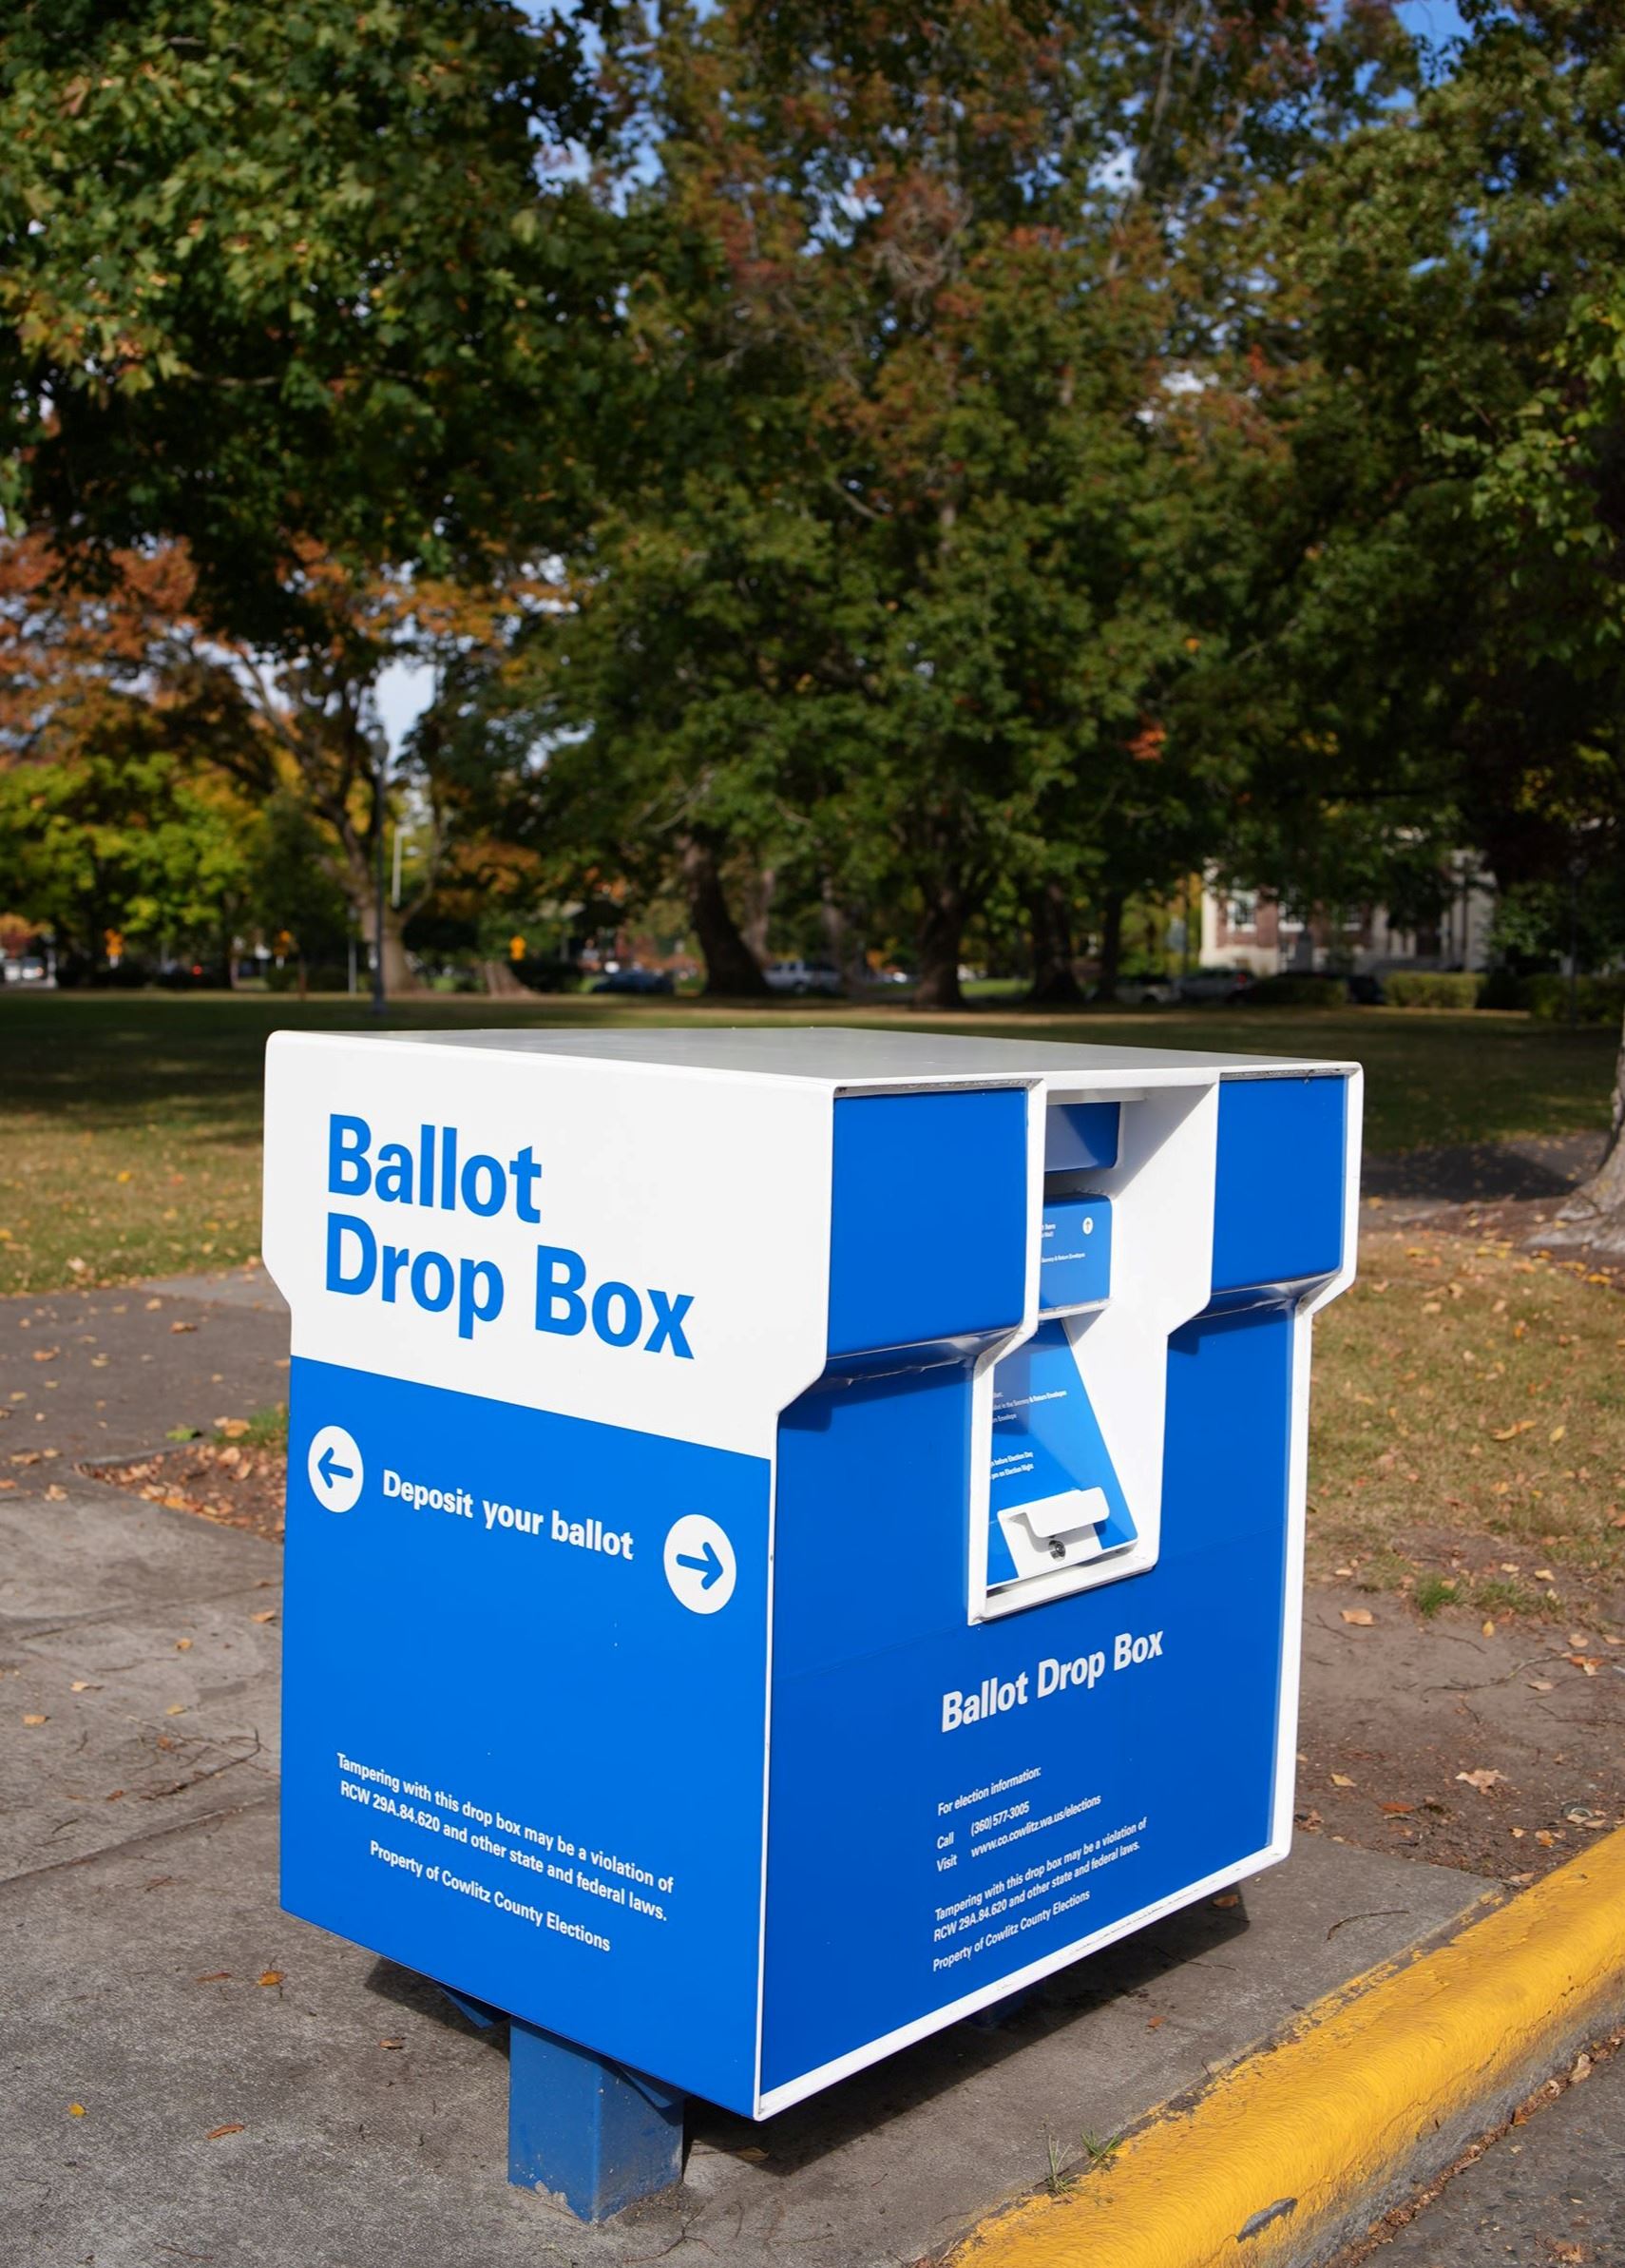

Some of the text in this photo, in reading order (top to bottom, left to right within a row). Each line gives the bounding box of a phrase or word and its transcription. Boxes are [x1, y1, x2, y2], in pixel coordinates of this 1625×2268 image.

[328, 1114, 542, 1223] Ballot
[326, 1212, 695, 1359] Drop Box
[383, 1469, 633, 1560] Deposit your ballot
[942, 1630, 1164, 1733] Ballot Drop Box
[336, 1752, 675, 1893] Tampering with this drop box may be a violation of
[936, 1795, 1101, 1873] Visit www.co.cowlitz.wa.us/elections
[937, 1800, 1030, 1850] Call (360) 577-3005
[938, 1766, 1042, 1816] For election information:
[340, 1780, 667, 1921] RCW 29A.84.620 and other state and federal laws.
[370, 1840, 611, 1951] Property of Cowlitz County Elections
[933, 1841, 1140, 1942] RCW 29A.84.620 and other state and federal laws.
[935, 1816, 1147, 1922] Tampering with this drop box may be a violation of
[933, 1890, 1090, 1971] Property of Cowlitz County Elections
